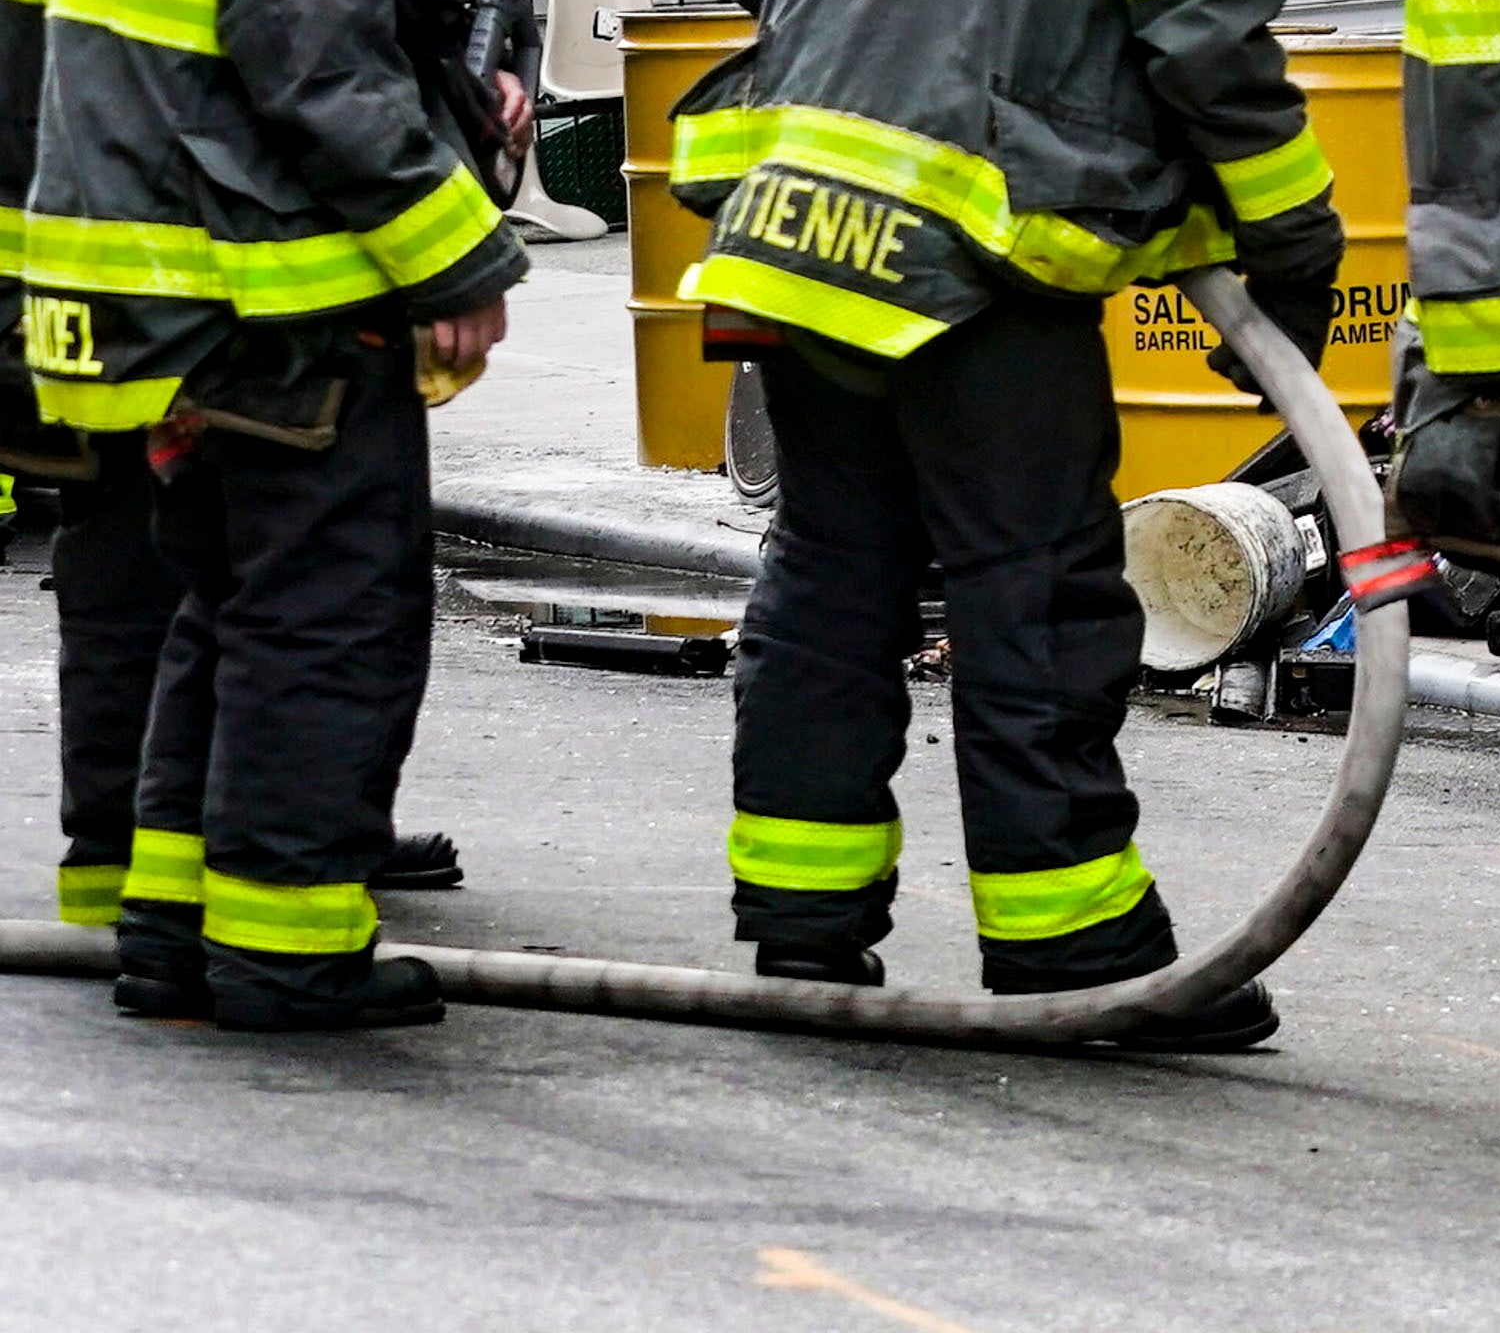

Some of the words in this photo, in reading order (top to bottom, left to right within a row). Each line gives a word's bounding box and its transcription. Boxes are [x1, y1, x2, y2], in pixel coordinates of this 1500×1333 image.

[717, 171, 924, 283] TIENNE
[1135, 330, 1214, 351] BARRIL
[1329, 321, 1399, 345] AMEN
